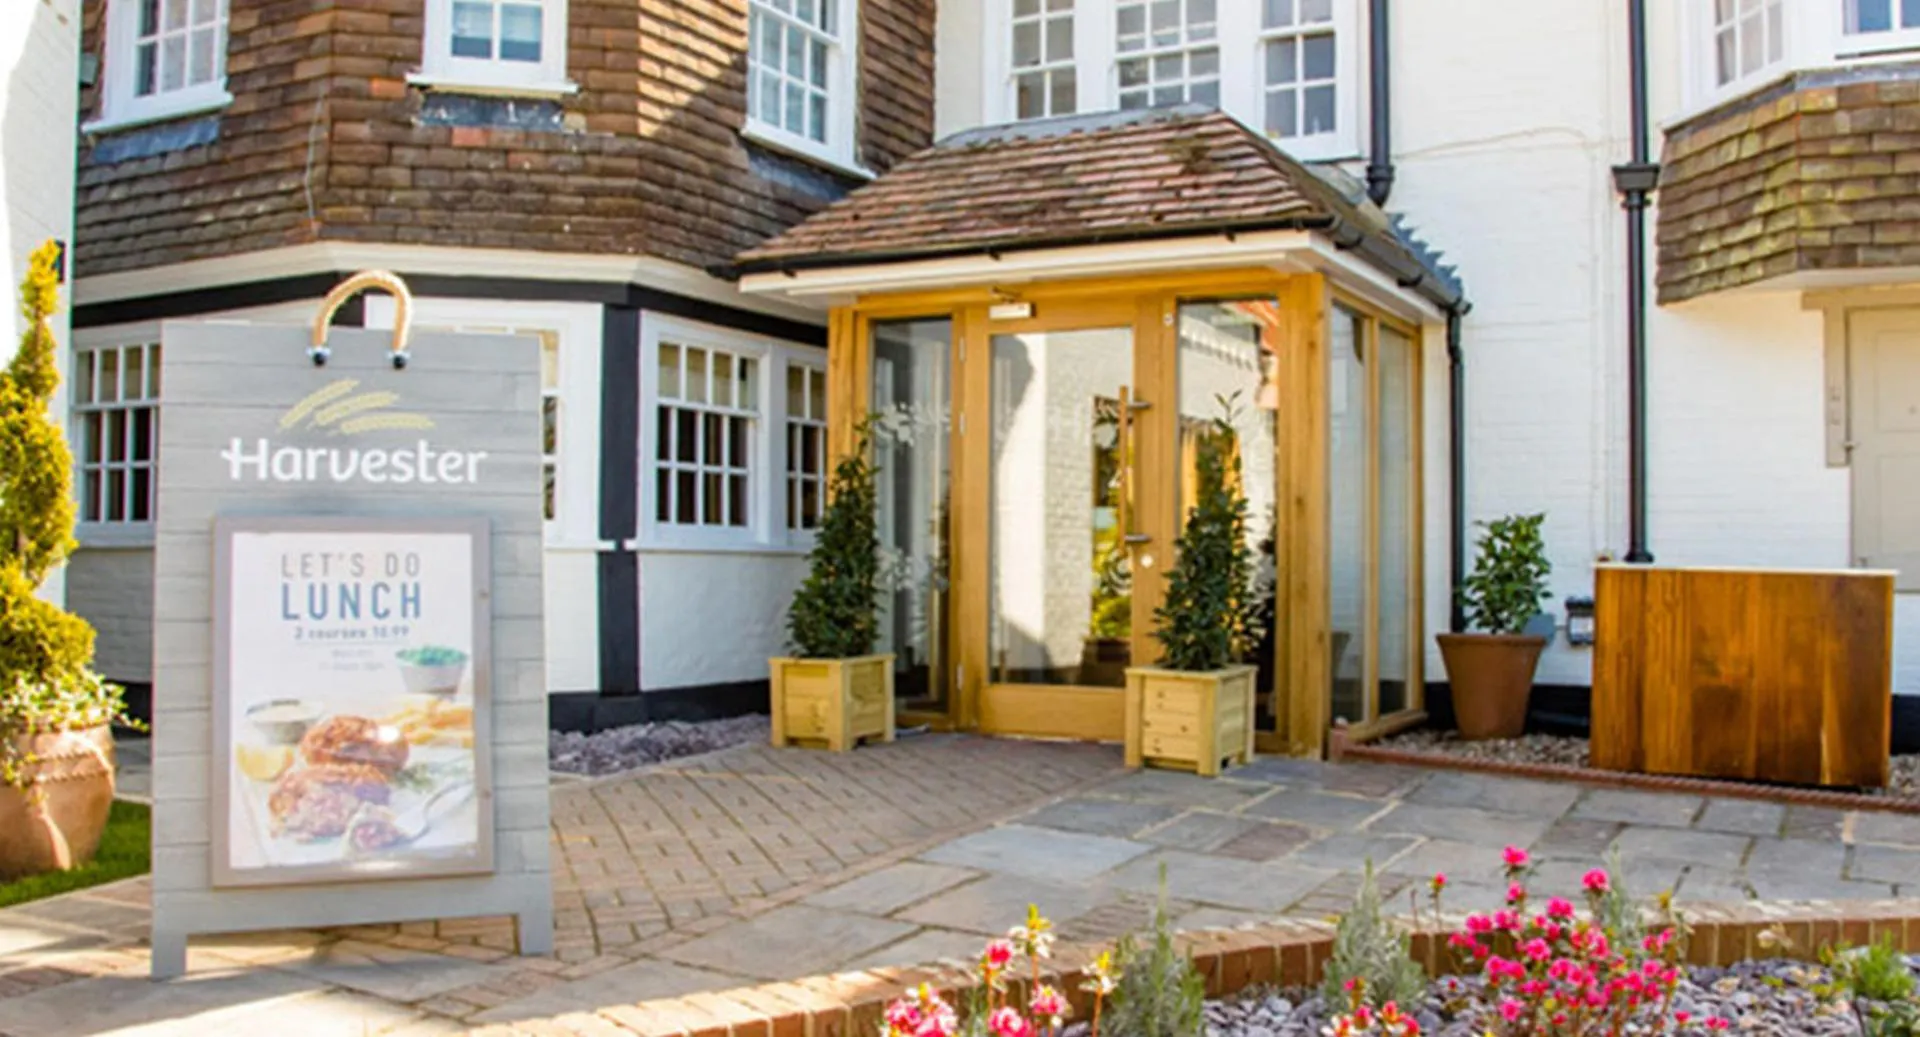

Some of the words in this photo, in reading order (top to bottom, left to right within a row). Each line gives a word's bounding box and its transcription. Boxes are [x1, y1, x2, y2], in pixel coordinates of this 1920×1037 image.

[220, 436, 489, 483] Harvester
[281, 553, 365, 578] LET'S
[385, 553, 421, 578] DO
[281, 582, 421, 620] LUNCH
[308, 628, 367, 639] courses
